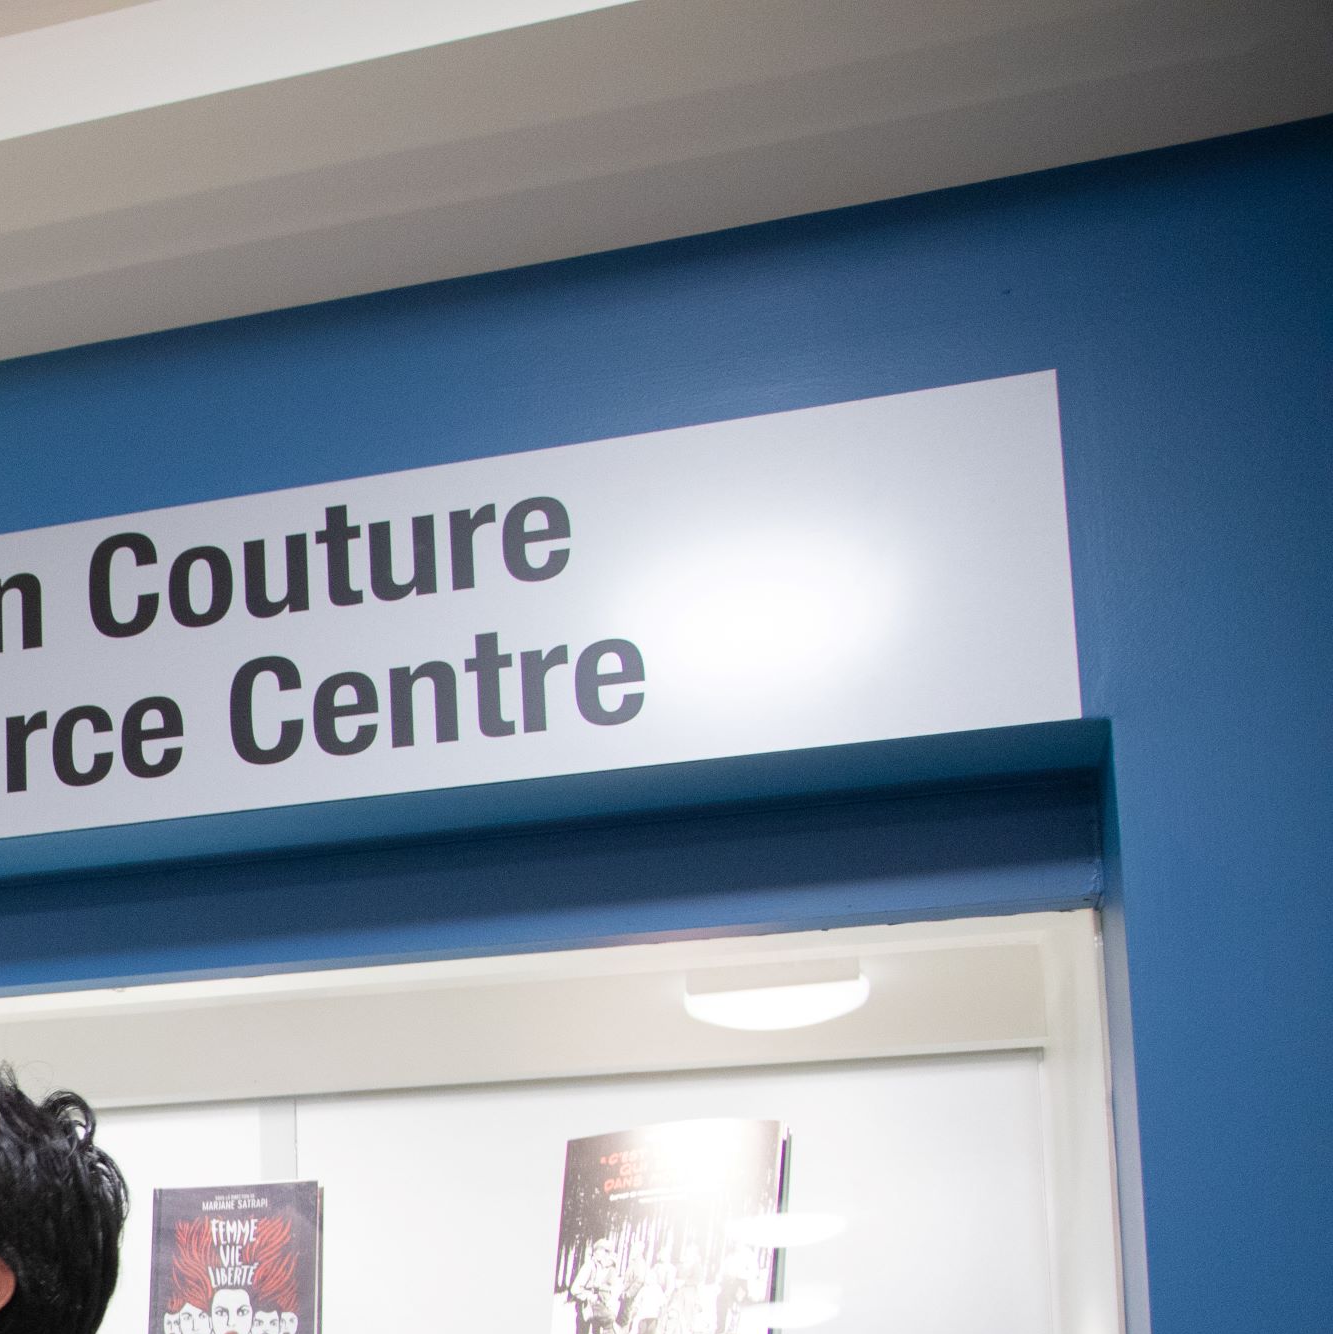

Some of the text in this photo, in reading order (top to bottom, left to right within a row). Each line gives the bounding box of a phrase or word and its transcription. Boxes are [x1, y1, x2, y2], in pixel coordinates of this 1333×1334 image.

[88, 494, 572, 638] Couture
[229, 630, 647, 765] Centre
[202, 1197, 268, 1211] MARJANE SATRAPI
[211, 1218, 258, 1247] FEMME
[219, 1244, 243, 1268] VIE
[208, 1262, 259, 1288] LIBERTÉ
